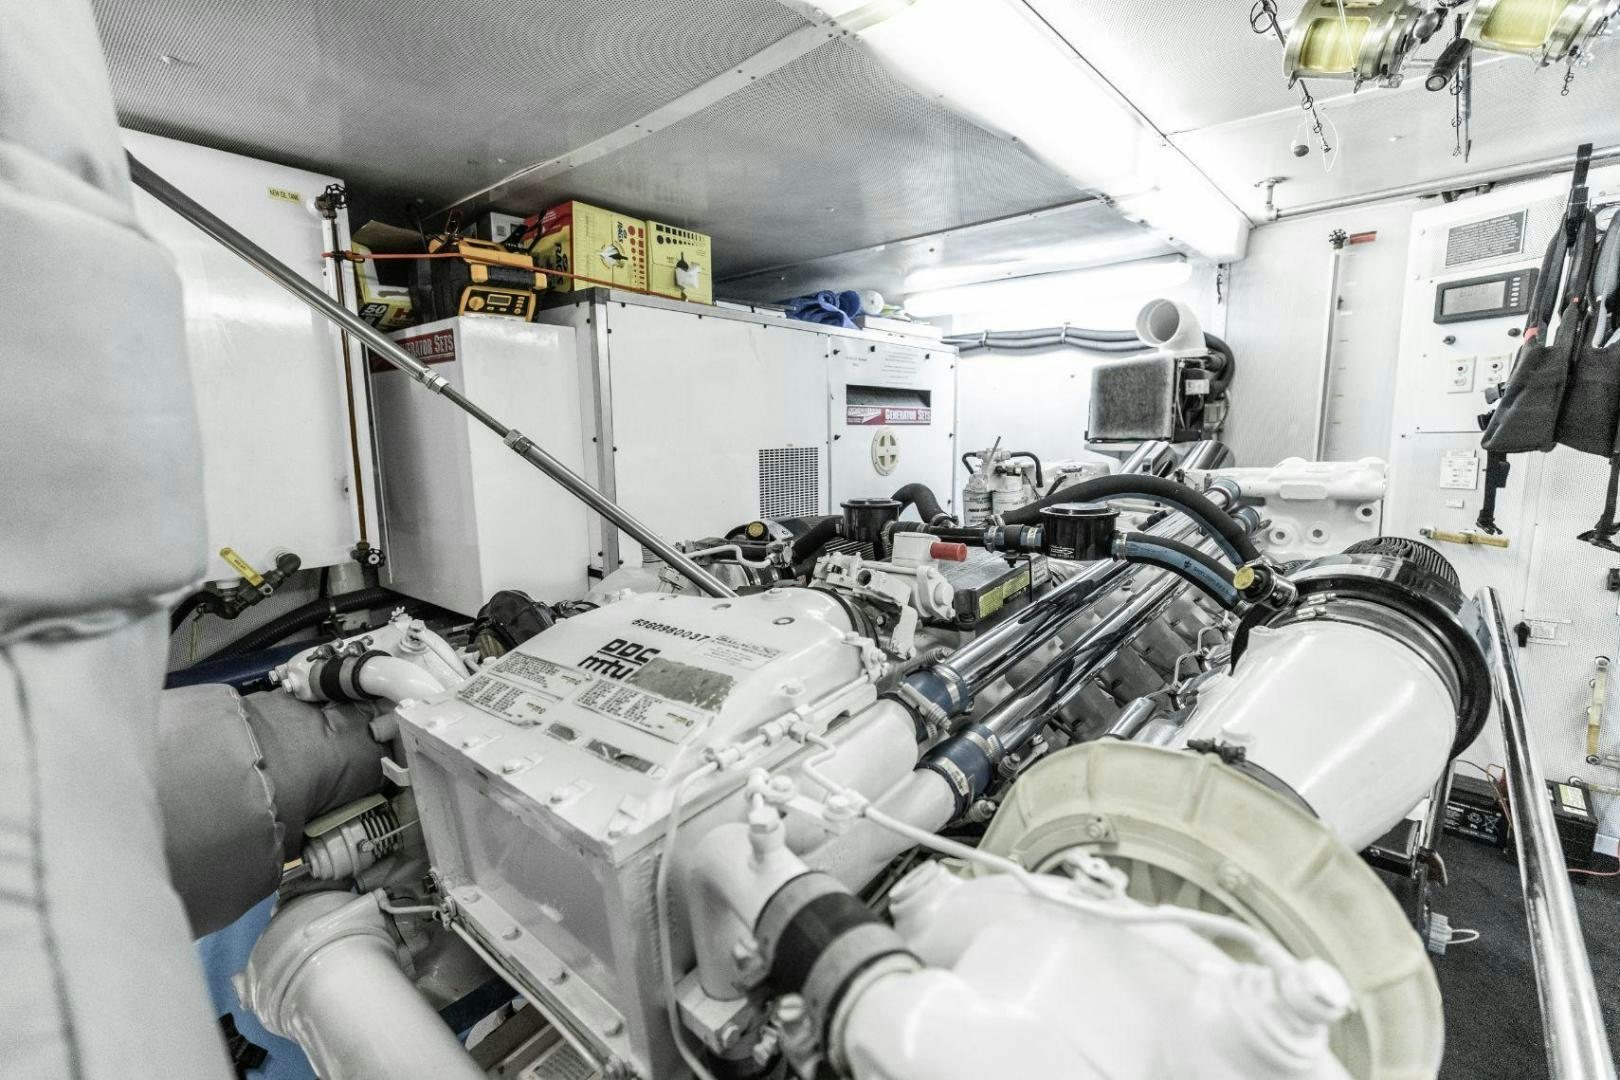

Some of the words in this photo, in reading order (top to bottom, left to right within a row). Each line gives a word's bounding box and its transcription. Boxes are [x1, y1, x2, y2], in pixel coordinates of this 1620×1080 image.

[364, 304, 387, 314] 50
[399, 338, 433, 358] ERATOR
[433, 334, 454, 354] SETS
[885, 408, 917, 421] GENERATOR
[601, 638, 661, 664] DDC
[577, 655, 634, 681] mtu
